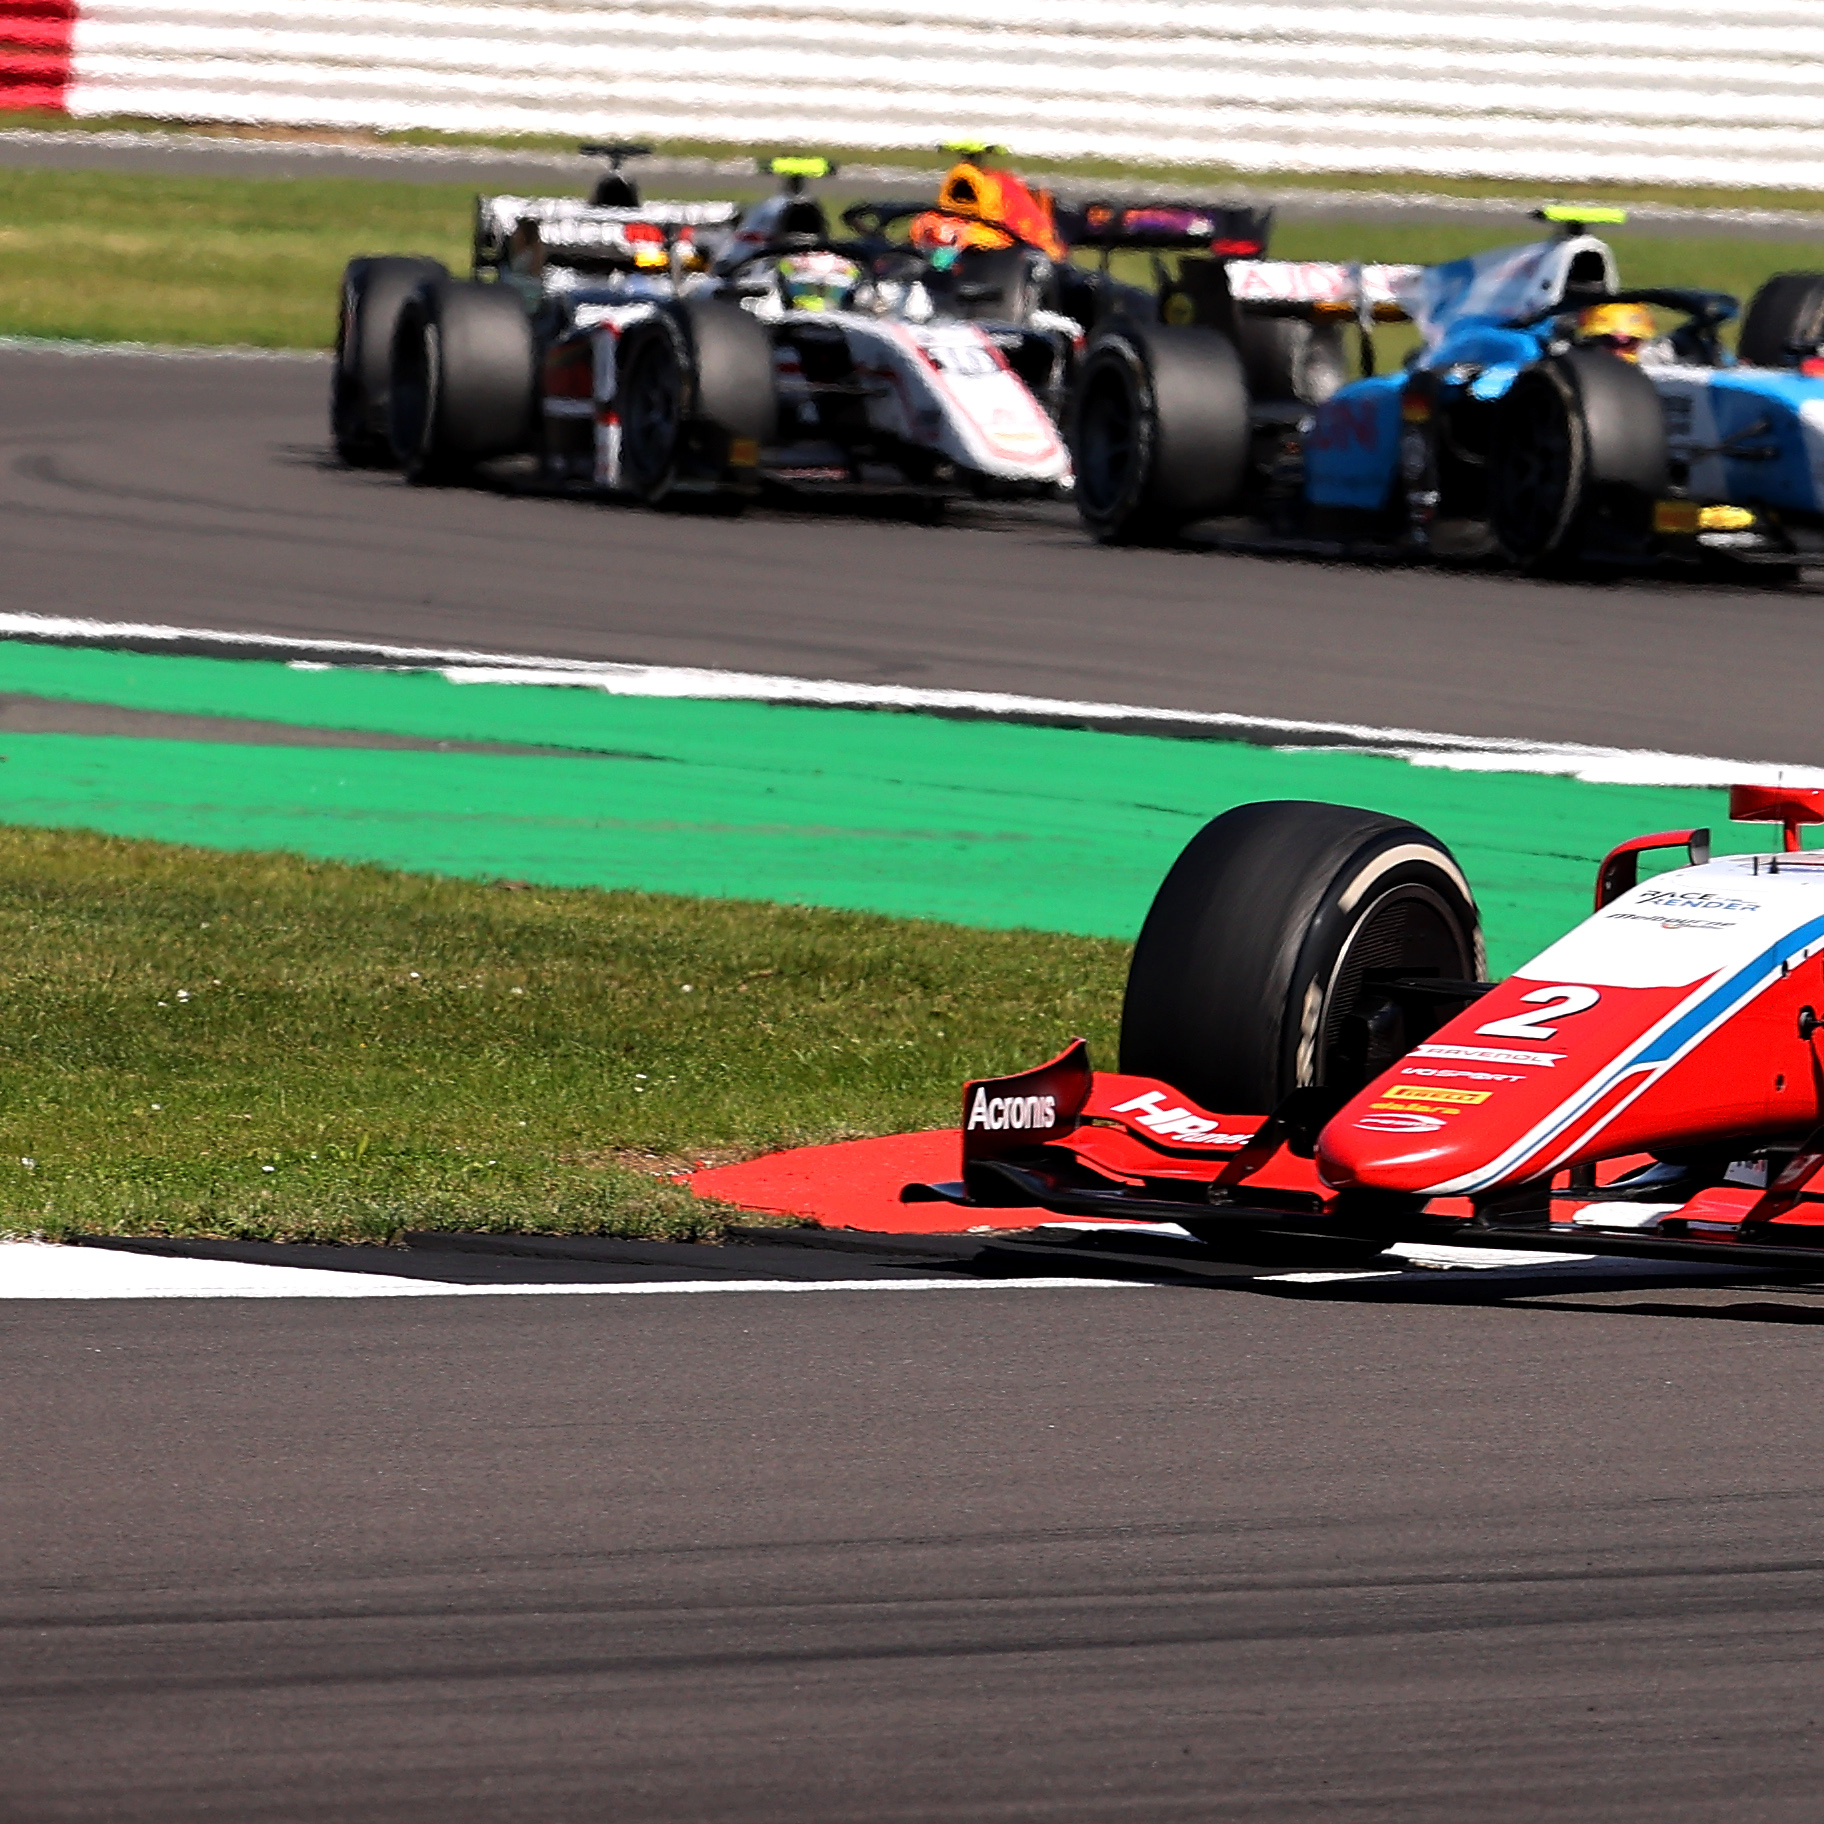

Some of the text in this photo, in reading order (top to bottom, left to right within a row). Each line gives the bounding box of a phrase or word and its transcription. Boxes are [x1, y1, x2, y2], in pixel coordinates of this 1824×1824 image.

[1474, 984, 1602, 1041] 2
[1425, 1046, 1543, 1064] RAVENOL
[1110, 1090, 1220, 1135] HP
